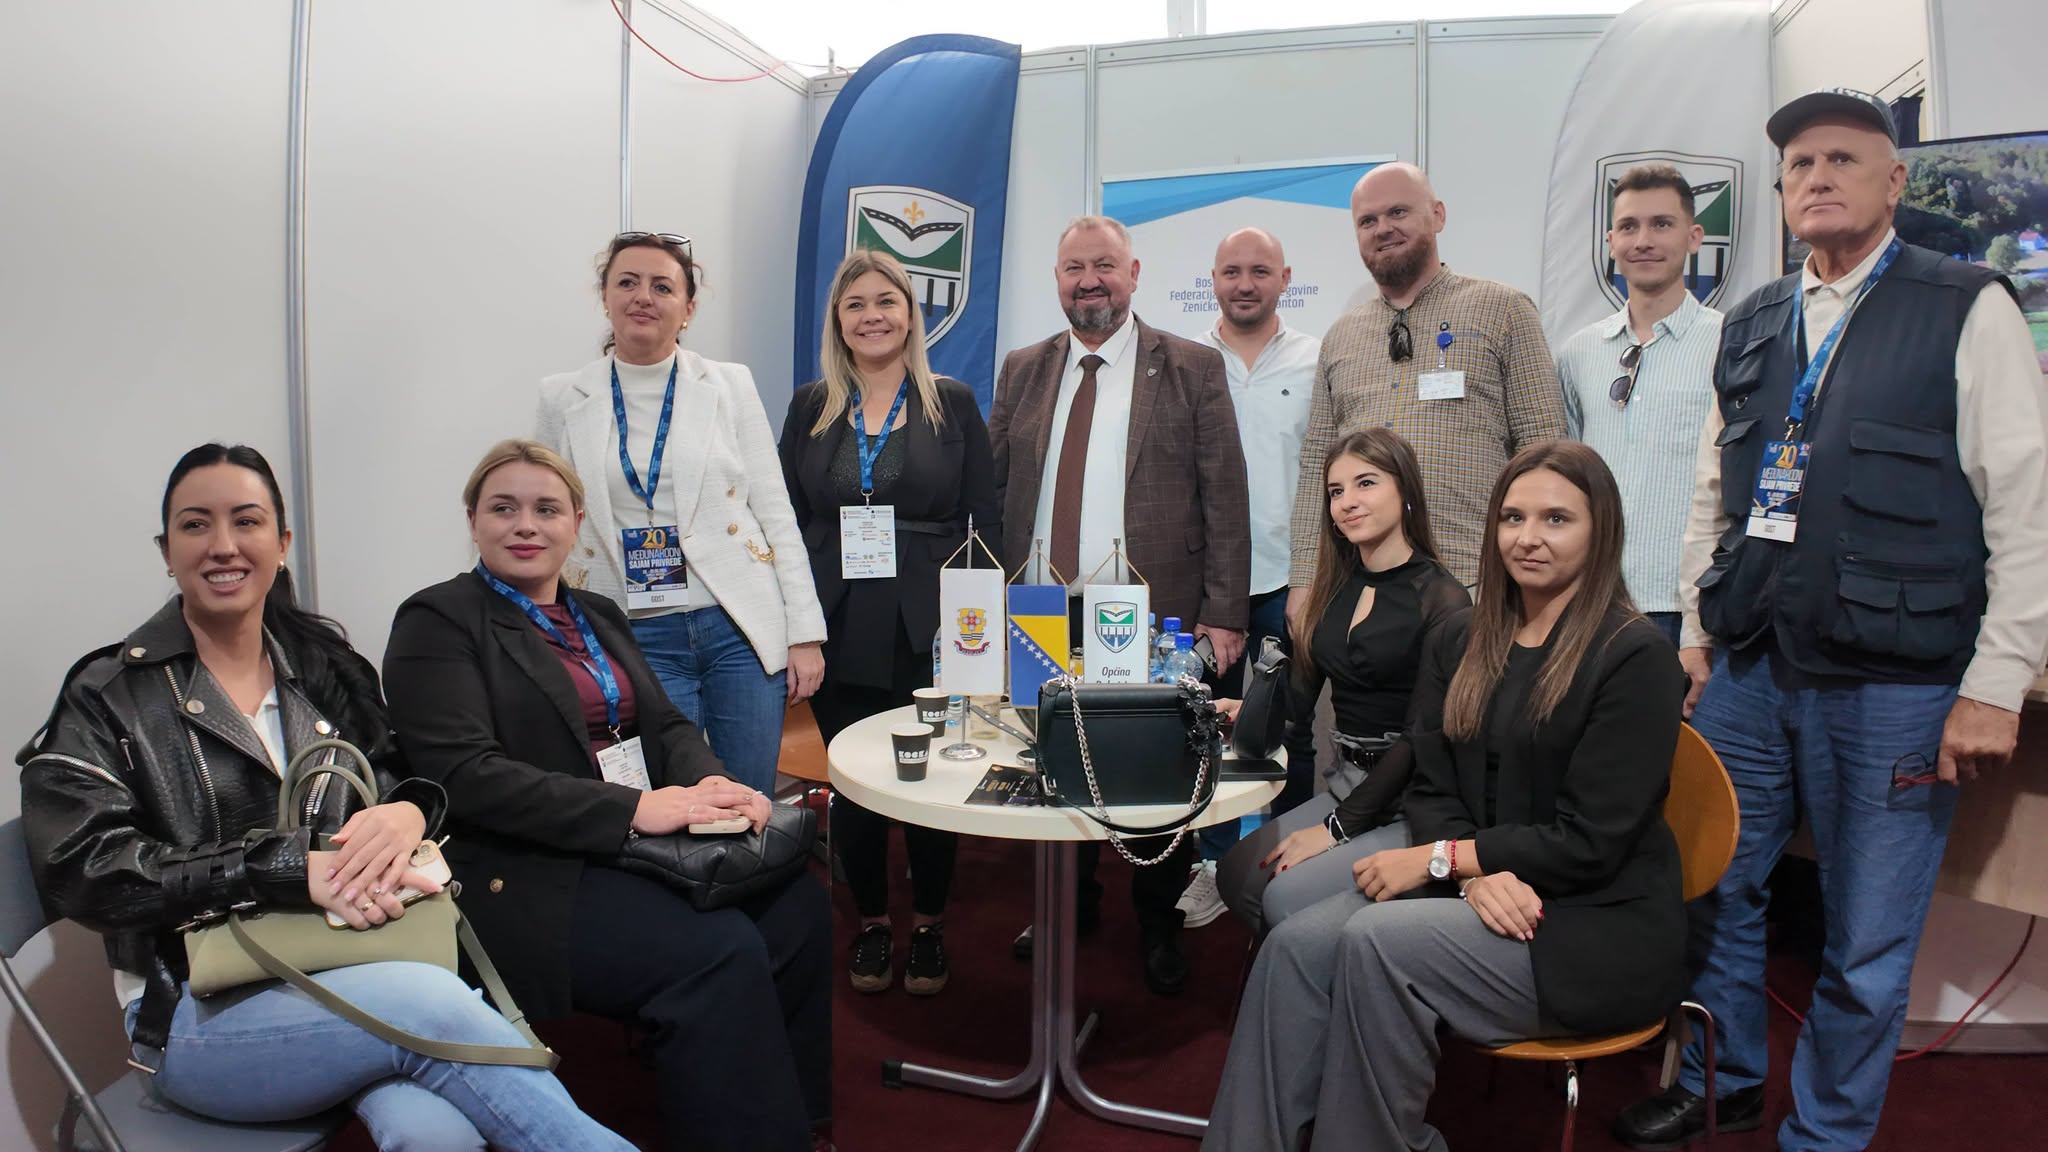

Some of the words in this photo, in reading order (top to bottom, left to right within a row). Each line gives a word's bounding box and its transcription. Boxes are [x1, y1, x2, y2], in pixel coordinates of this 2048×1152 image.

[1195, 277, 1213, 288] Bos
[1286, 284, 1319, 298] govine
[1276, 298, 1304, 309] anton
[1775, 445, 1798, 469] 20
[640, 529, 666, 548] 20
